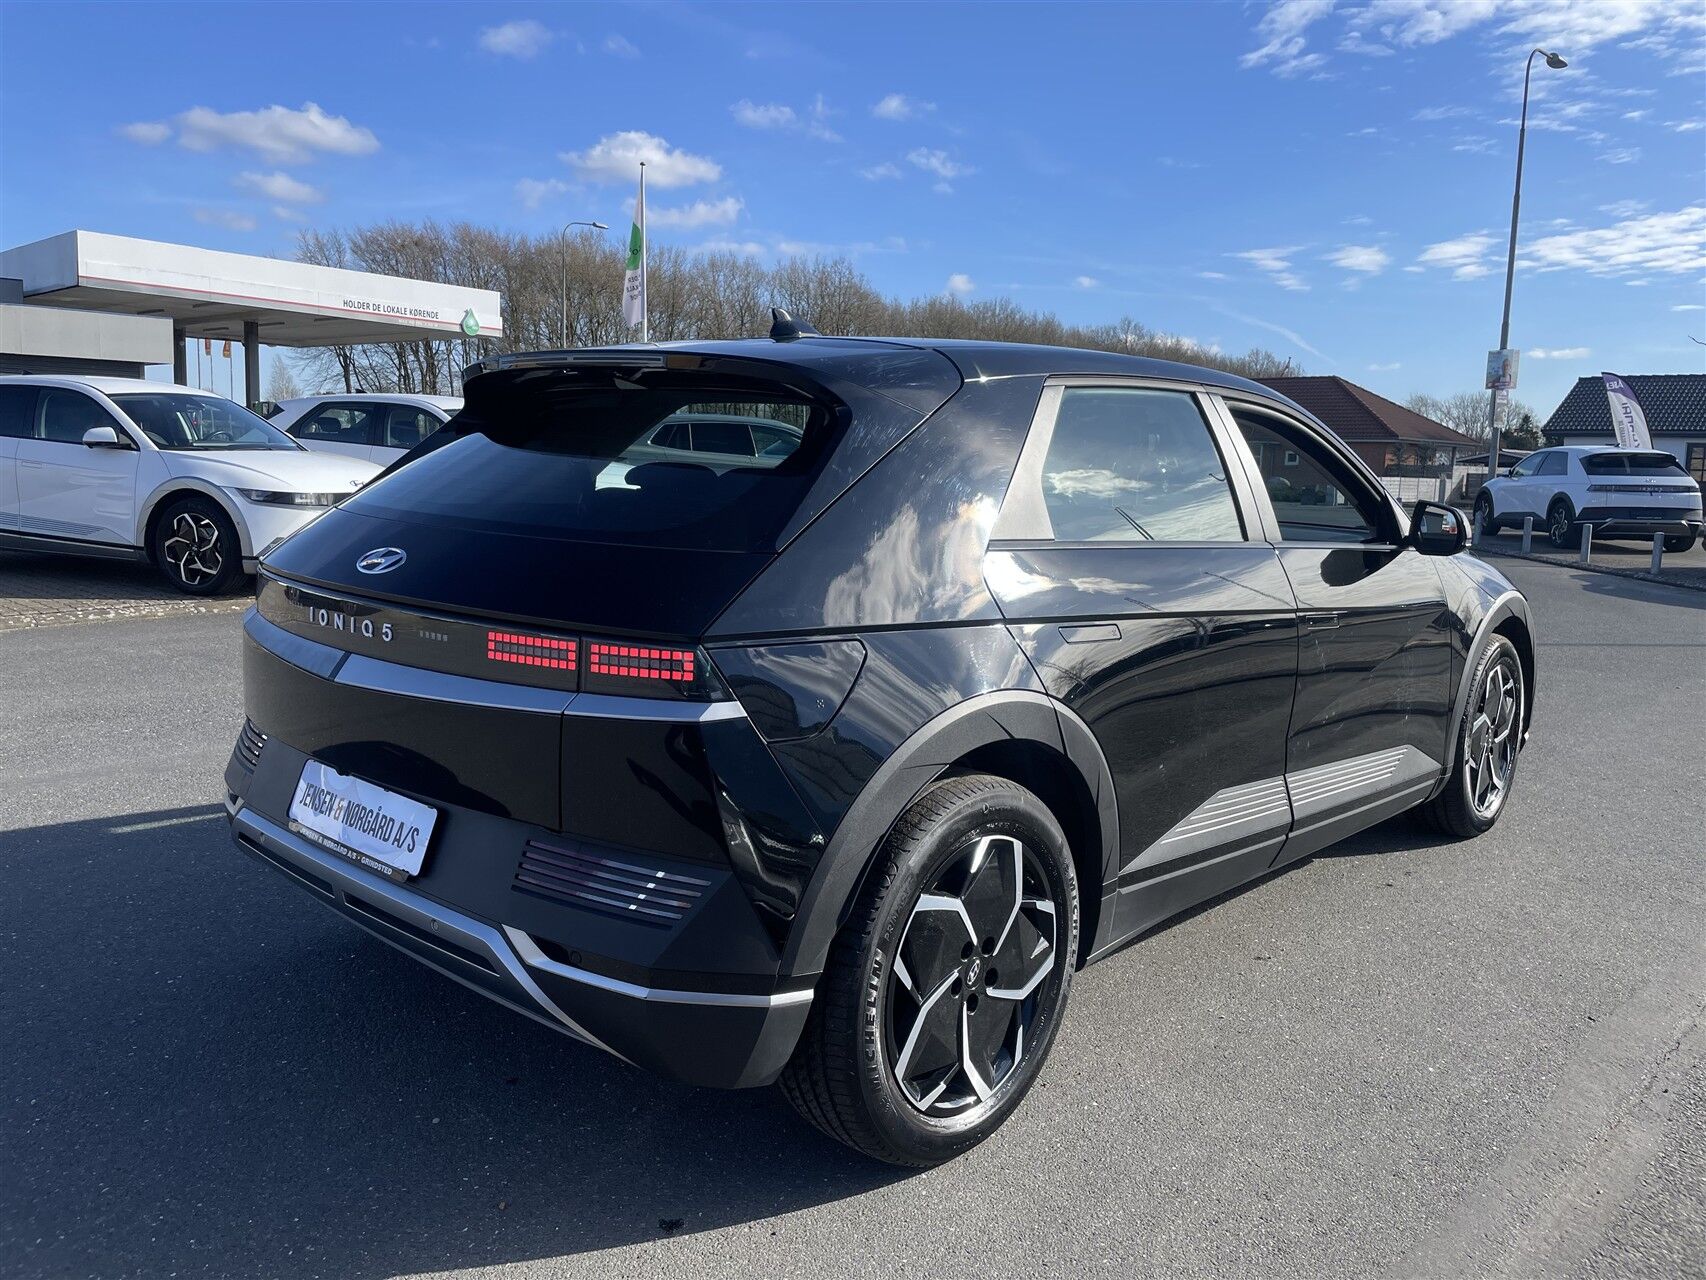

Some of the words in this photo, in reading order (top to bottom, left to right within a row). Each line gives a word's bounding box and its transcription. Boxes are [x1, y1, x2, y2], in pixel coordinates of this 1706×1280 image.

[343, 299, 371, 311] HOLDER
[372, 303, 382, 312] DE
[382, 304, 408, 315] LOKALE
[409, 308, 439, 320] KØRENDE
[309, 606, 374, 638] IONIQ
[382, 623, 394, 642] 5
[299, 782, 338, 817] JENSEN
[333, 797, 346, 821] &
[341, 800, 396, 844] NØRGÅRD
[392, 820, 420, 854] A/S
[299, 827, 319, 843] JENSEN
[323, 837, 348, 857] NØRGÅRD
[360, 856, 393, 876] GRINDSTED
